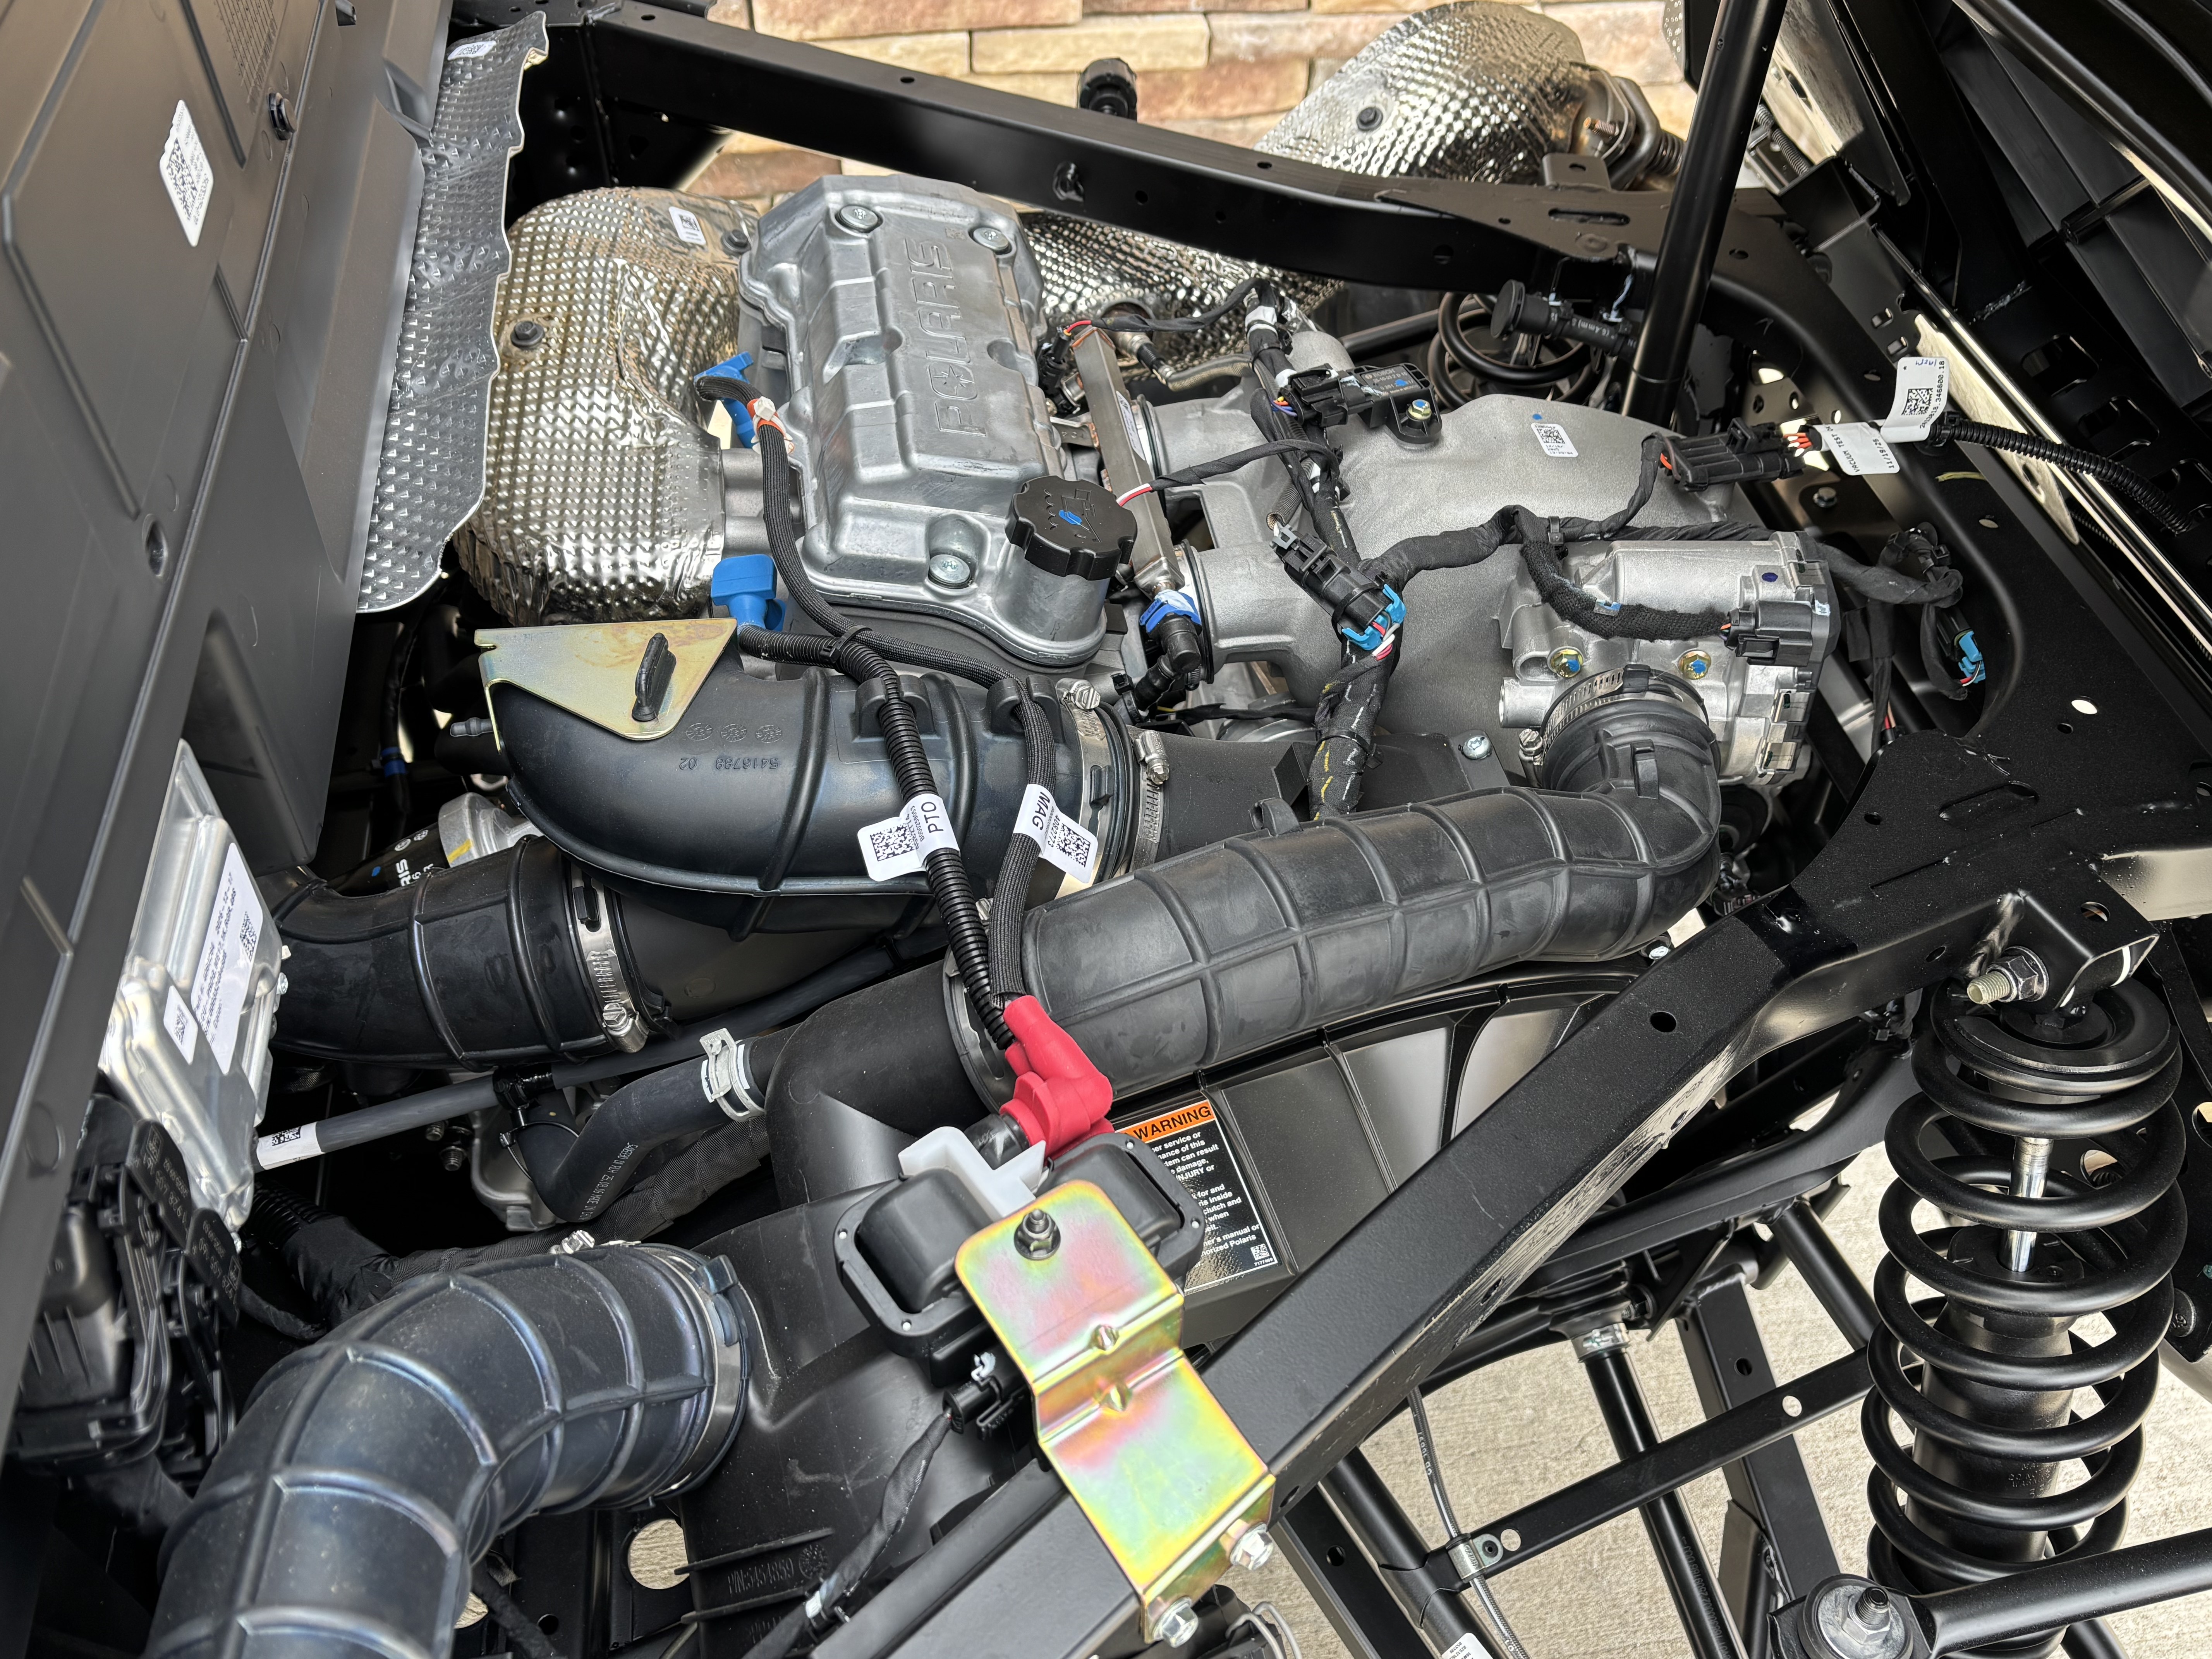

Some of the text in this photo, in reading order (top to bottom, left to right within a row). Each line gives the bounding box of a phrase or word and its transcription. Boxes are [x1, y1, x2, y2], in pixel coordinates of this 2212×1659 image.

[905, 238, 986, 436] POLARIS
[1831, 433, 1844, 448] TEST
[1843, 450, 1860, 472] VACUUM
[679, 757, 778, 770] 5416788 02
[921, 802, 943, 833] PTO
[1033, 792, 1049, 830] MAG
[1048, 815, 1060, 847] 4082773
[1133, 1106, 1212, 1140] WARNING
[1163, 1135, 1192, 1149] service
[1192, 1131, 1201, 1139] or
[1181, 1144, 1189, 1152] of
[1189, 1140, 1206, 1149] this
[1181, 1153, 1195, 1161] can
[1197, 1144, 1219, 1156] result
[1176, 1158, 1209, 1173] damage,
[1197, 1190, 1209, 1198] for
[1210, 1183, 1225, 1194] and
[1209, 1191, 1233, 1203] inside
[1203, 1197, 1242, 1214] clutch and
[1208, 1211, 1230, 1222] when
[1222, 1226, 1250, 1240] manual
[1229, 1234, 1257, 1247] Polaris
